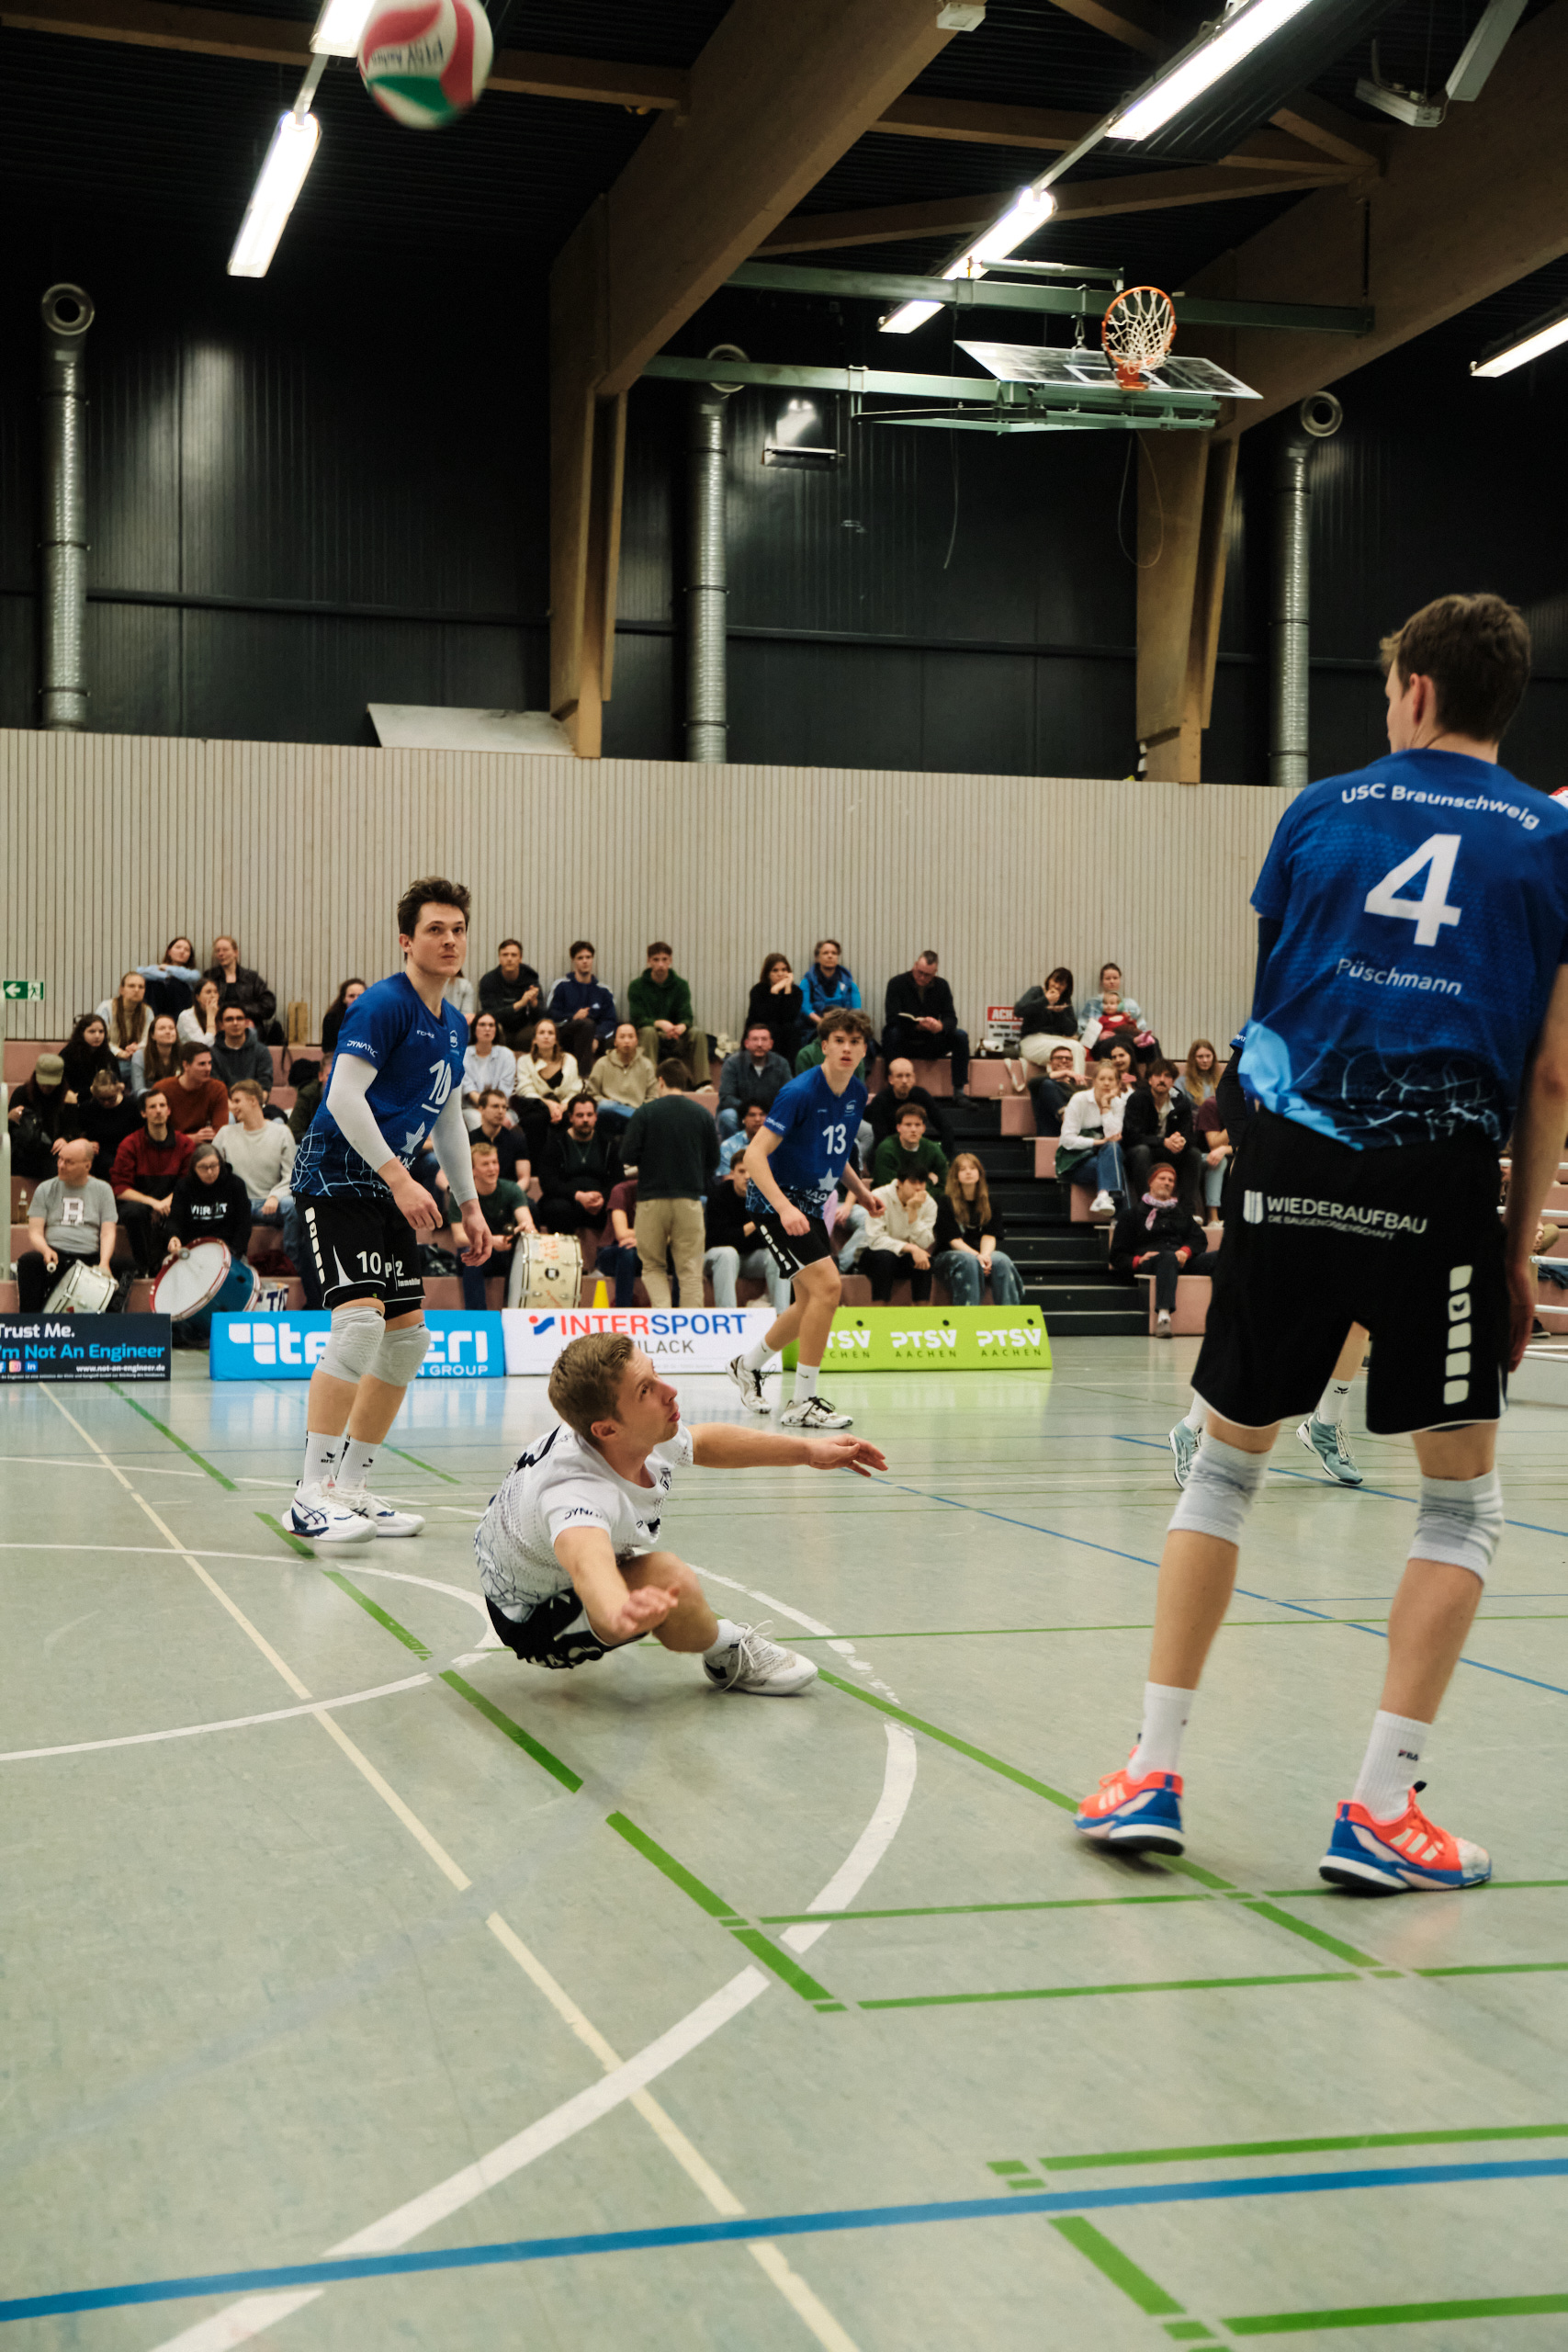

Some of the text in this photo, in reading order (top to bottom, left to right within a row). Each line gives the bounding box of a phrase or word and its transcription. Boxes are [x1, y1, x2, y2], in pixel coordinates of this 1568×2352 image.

[1342, 783, 1540, 831] USC Braunschweig
[1364, 833, 1461, 946] 4
[1337, 958, 1462, 996] Püschmann
[822, 1124, 847, 1155] 13
[1267, 1196, 1427, 1234] WIEDERAUFBAU
[356, 1250, 382, 1275] 10
[0, 1322, 75, 1339] Trust Me.
[560, 1314, 747, 1335] INTERSPORT
[827, 1329, 871, 1349] TSV
[890, 1329, 957, 1349] PTSV
[976, 1328, 1042, 1348] PTSV
[25, 1344, 56, 1359] Not
[61, 1343, 85, 1359] An
[89, 1343, 165, 1363] Engineer
[895, 1350, 957, 1359] AACHEN
[980, 1349, 1042, 1358] AACHEN
[76, 1363, 165, 1374] www.not-an-engineer.de
[429, 1364, 489, 1376] GROUP
